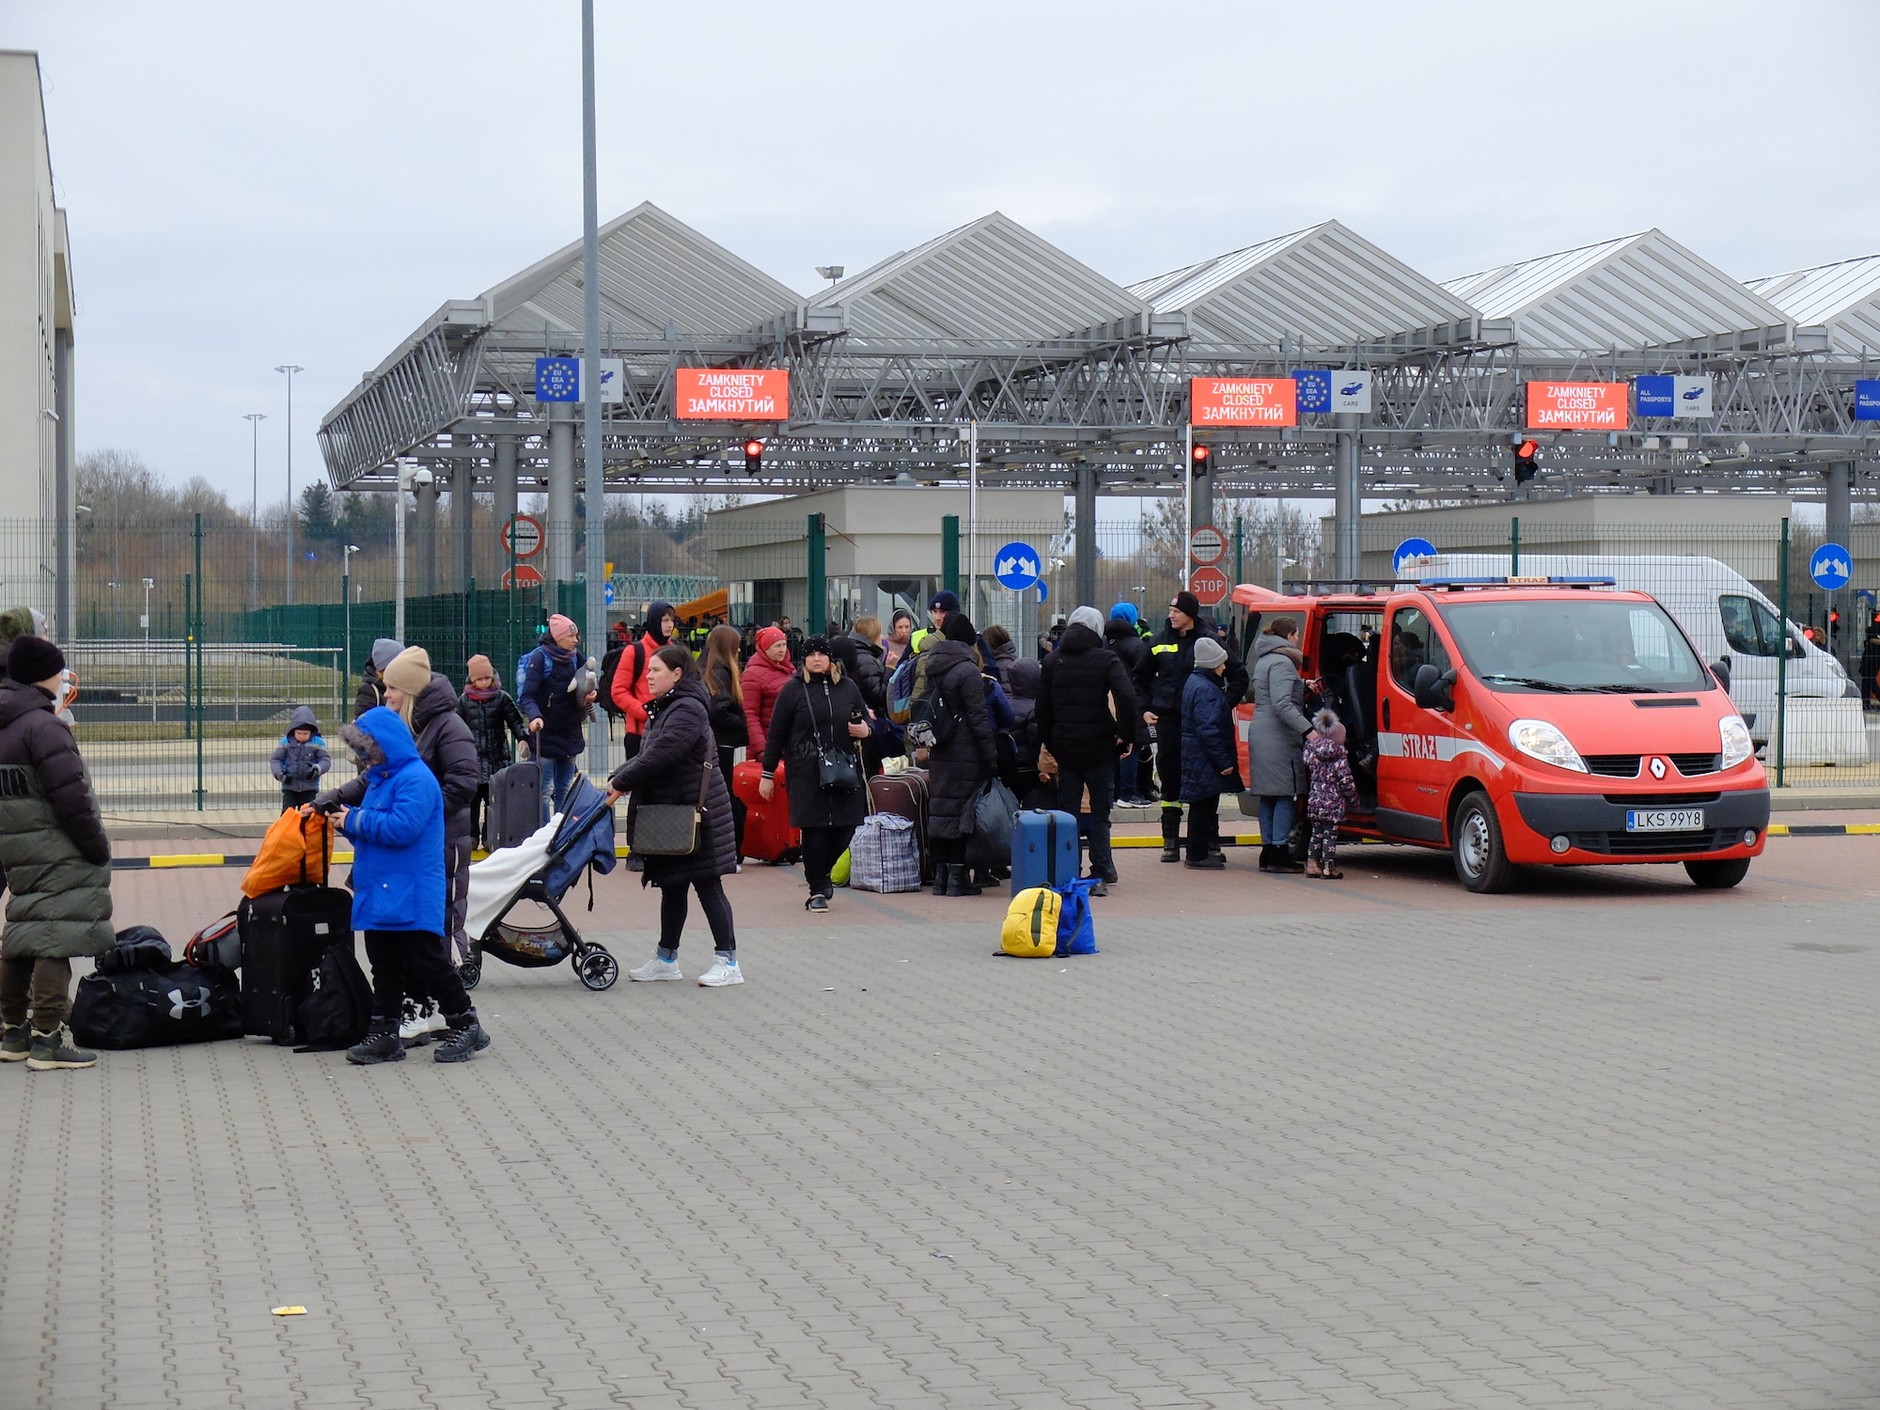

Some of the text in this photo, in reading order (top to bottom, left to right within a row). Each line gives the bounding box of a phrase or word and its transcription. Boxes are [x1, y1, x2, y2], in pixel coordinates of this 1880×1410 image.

[710, 386, 753, 398] CLOSED
[688, 396, 775, 413] ЗАМКНУТИЙ
[1222, 394, 1264, 406] CLOSED
[1557, 398, 1596, 409] CLOSED
[1203, 404, 1284, 420] ЗАМКНУТИЙ
[1538, 407, 1615, 423] ЗАМКНУТИЙ
[1193, 580, 1224, 593] STOP
[1637, 812, 1701, 827] LKS 99Y8
